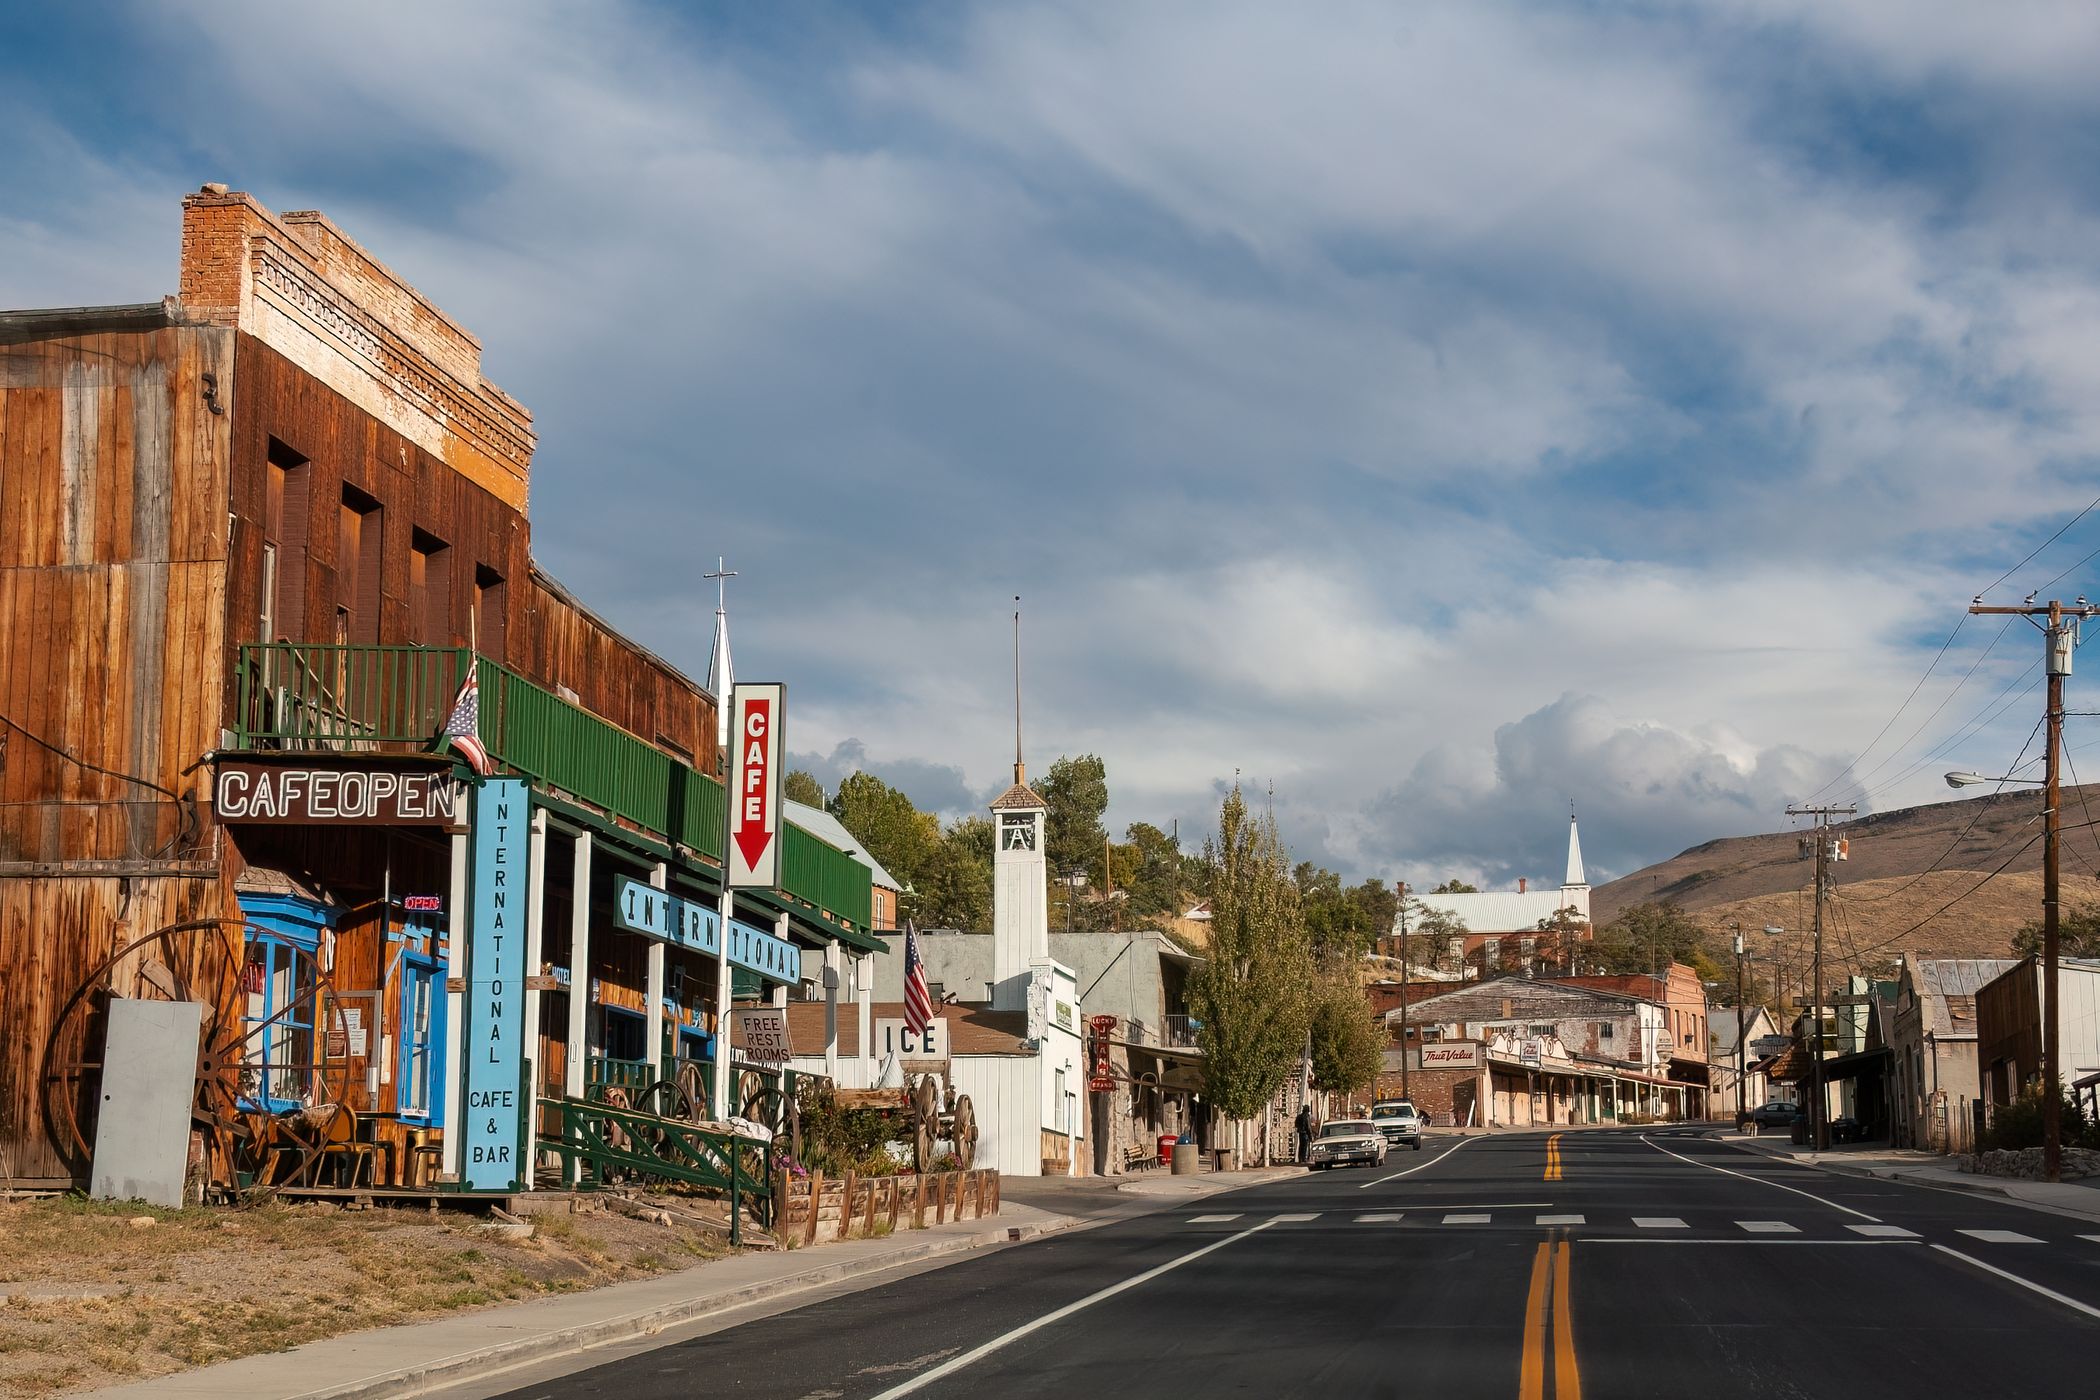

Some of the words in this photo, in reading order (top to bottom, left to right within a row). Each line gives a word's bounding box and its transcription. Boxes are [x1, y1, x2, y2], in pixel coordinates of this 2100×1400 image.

[746, 712, 765, 821] CAFE
[406, 899, 438, 909] OPEN
[489, 781, 508, 1064] INTERNATIONAL
[628, 888, 795, 979] INTERNTIONAL
[743, 1017, 780, 1031] FREE
[1092, 1017, 1113, 1025] LUCKY
[746, 1033, 781, 1046] REST
[886, 1026, 936, 1054] ICE
[746, 1047, 790, 1061] ROOMS
[1423, 1050, 1446, 1062] True
[1444, 1049, 1474, 1060] Value
[469, 1091, 512, 1108] CAFE
[486, 1117, 498, 1134] &
[473, 1146, 509, 1163] BAR
